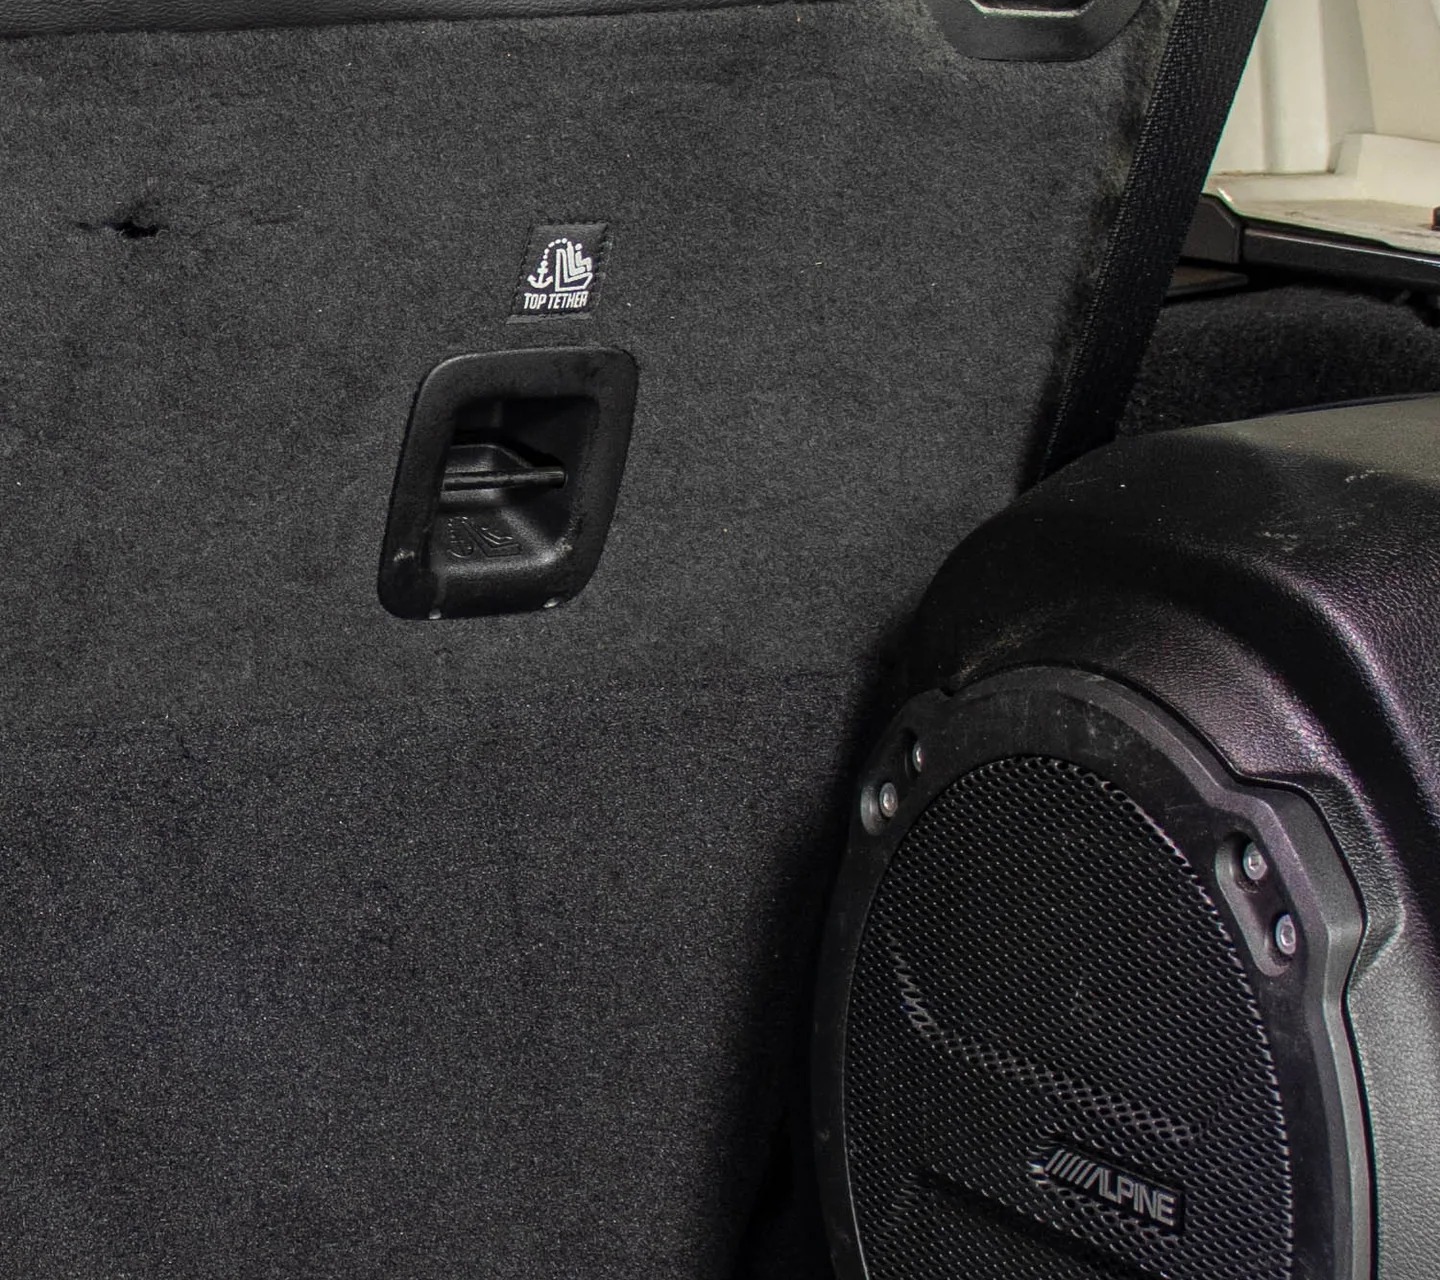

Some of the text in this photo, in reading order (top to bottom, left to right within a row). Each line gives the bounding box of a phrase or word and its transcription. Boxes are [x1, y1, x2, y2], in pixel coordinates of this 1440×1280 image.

[523, 290, 589, 310] TOP TETHER
[1082, 1163, 1178, 1229] ALPINE
